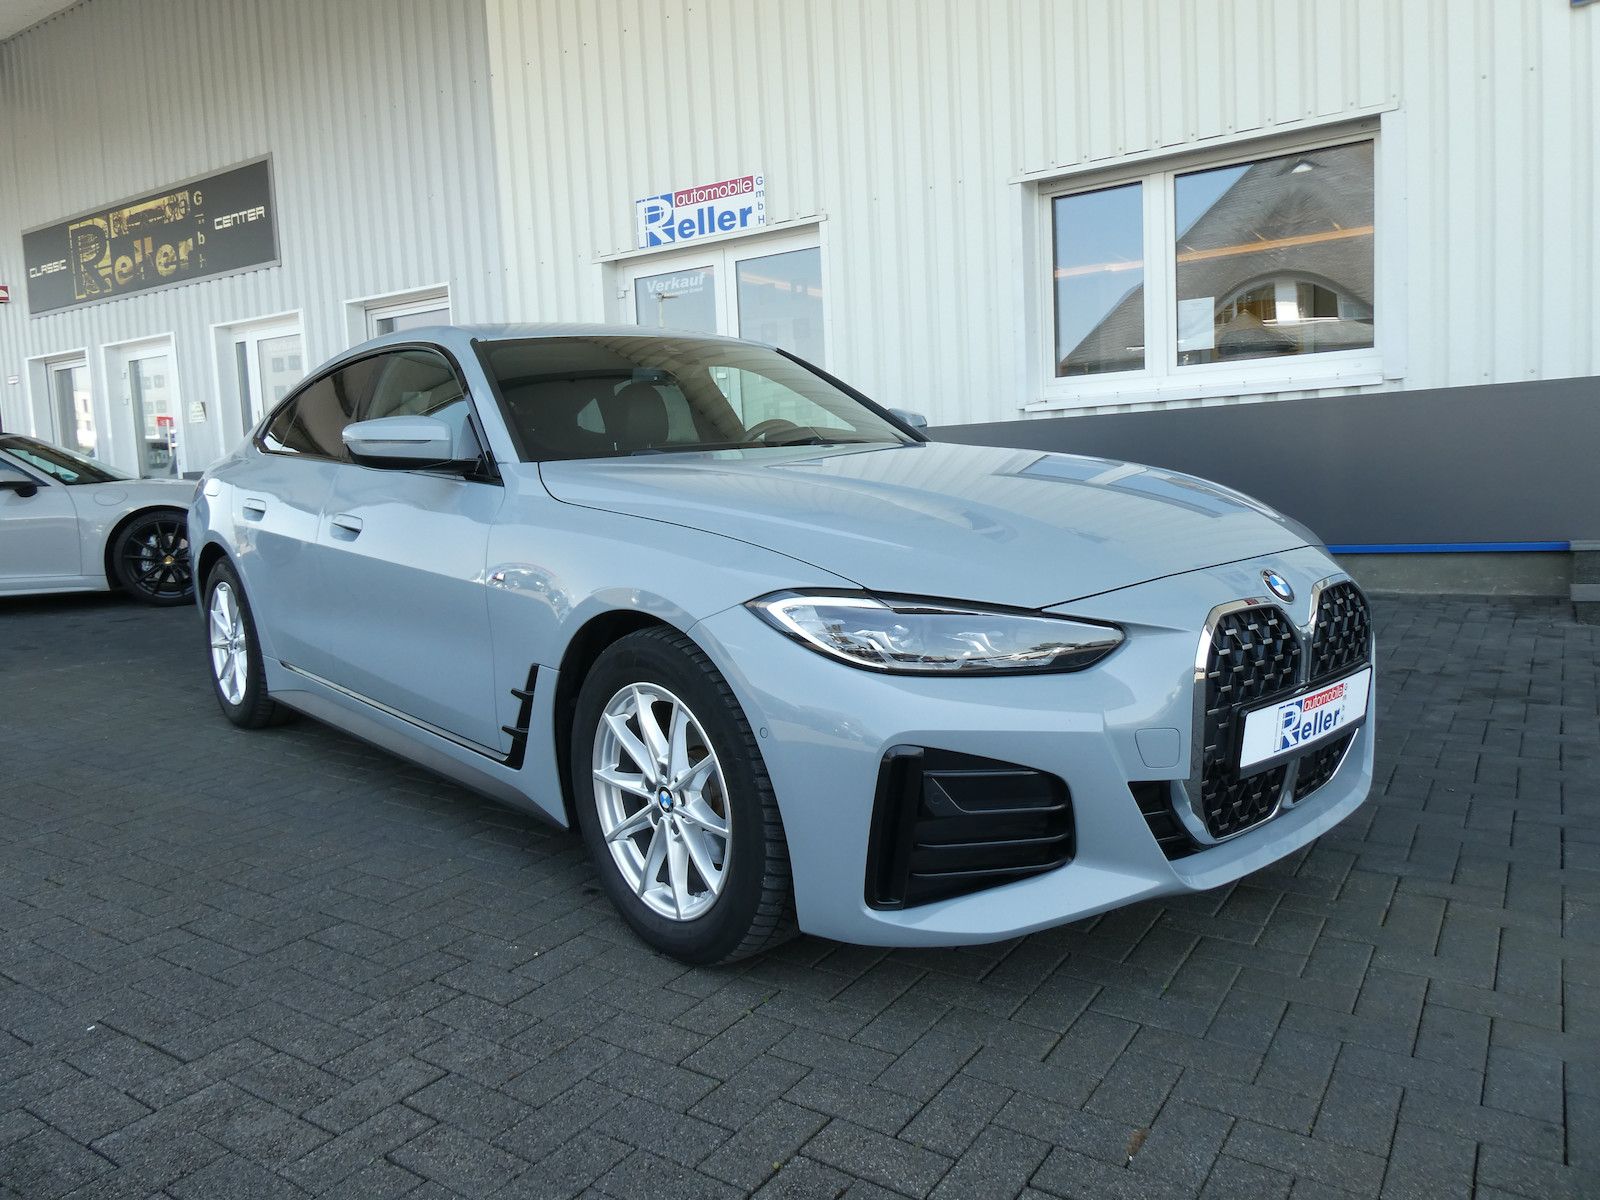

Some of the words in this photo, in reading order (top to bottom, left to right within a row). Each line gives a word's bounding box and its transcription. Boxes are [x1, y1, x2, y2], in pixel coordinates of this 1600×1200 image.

[676, 178, 753, 206] automobile
[755, 176, 765, 225] GmbH
[214, 205, 266, 231] CENTER
[636, 193, 753, 249] Reller
[29, 258, 67, 279] CLASSIC
[646, 272, 705, 293] Verkauf
[1303, 684, 1344, 711] automobile
[1273, 700, 1341, 753] Reller
